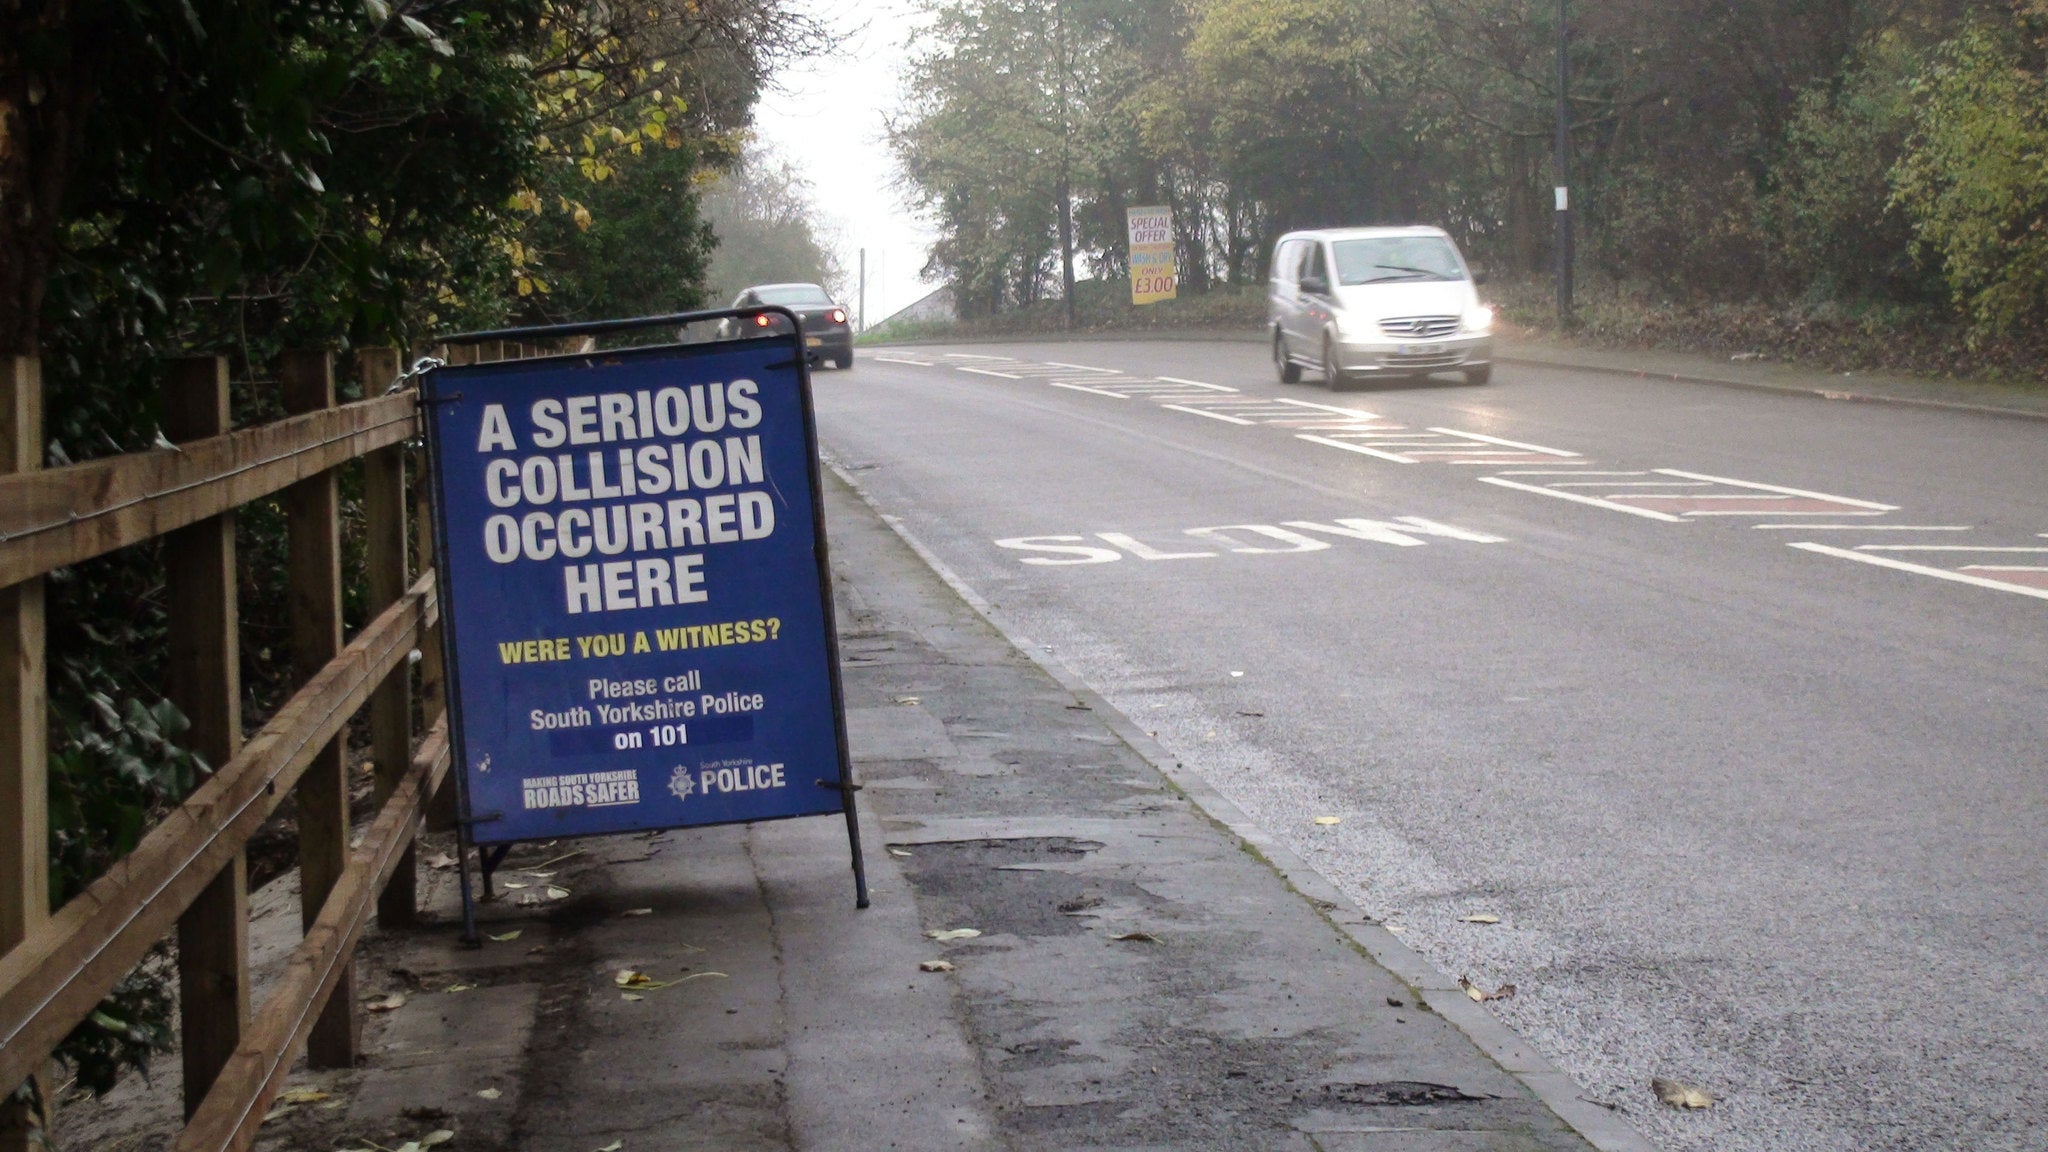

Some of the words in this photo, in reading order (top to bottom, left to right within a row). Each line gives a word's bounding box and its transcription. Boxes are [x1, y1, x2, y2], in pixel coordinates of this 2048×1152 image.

[1131, 216, 1169, 230] SPECIAL
[1135, 229, 1166, 242] OFFER
[1135, 277, 1173, 294] £3.00
[1142, 267, 1163, 275] ONLY
[478, 404, 517, 453] A
[531, 379, 763, 449] SERIOUS
[485, 435, 765, 508] COLLISION
[484, 490, 775, 563] OCCURRED
[994, 515, 1508, 566] SLOW
[564, 553, 709, 614] HERE
[499, 637, 571, 664] WERE
[577, 633, 625, 659] YOU
[633, 631, 651, 654] A
[655, 618, 781, 652] WITNESS?
[589, 677, 658, 700] Please
[664, 670, 701, 692] call
[530, 707, 592, 730] South
[599, 699, 695, 725] Yorkshire
[702, 691, 764, 716] Police
[615, 731, 642, 750] on
[650, 724, 688, 747] 101
[523, 776, 558, 789] MAKING
[558, 774, 588, 786] SOUTH
[588, 769, 637, 783] YORKSHIRE
[524, 785, 585, 809] ROADS
[585, 780, 640, 804] SAFER
[701, 763, 786, 795] POLICE
